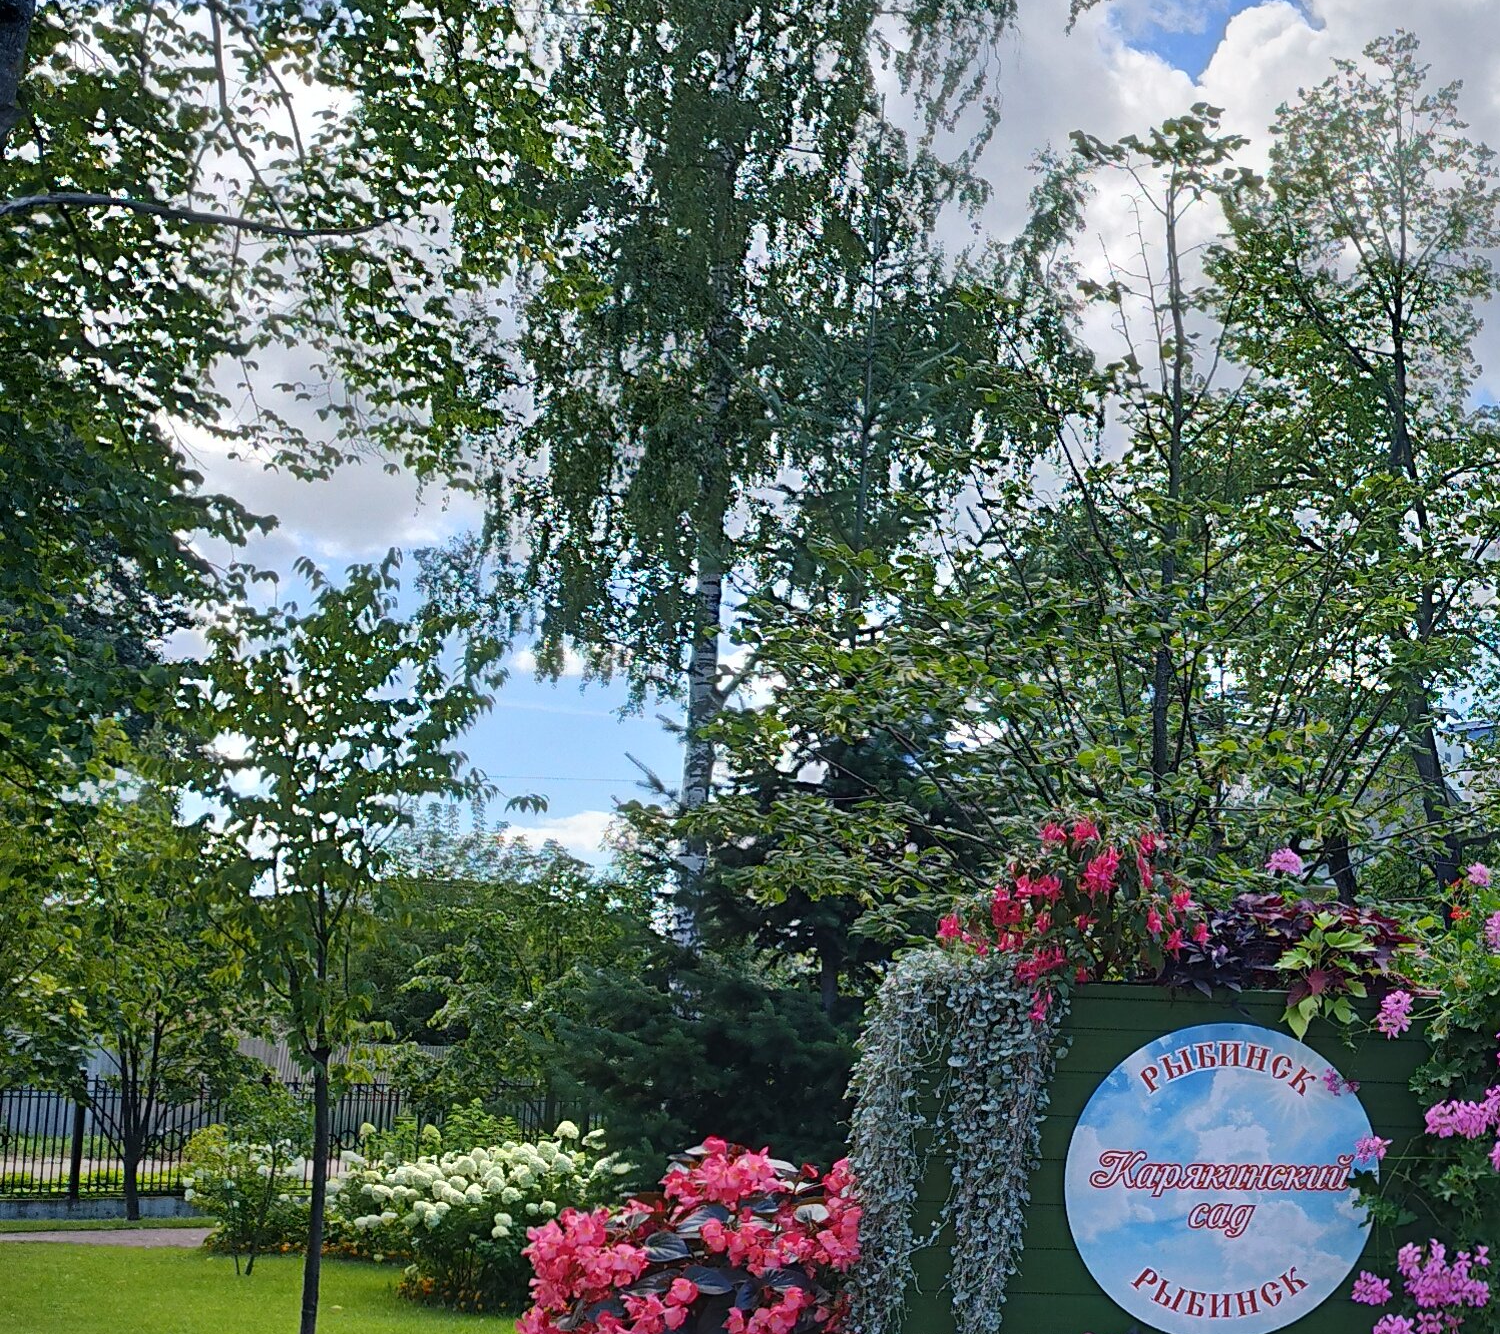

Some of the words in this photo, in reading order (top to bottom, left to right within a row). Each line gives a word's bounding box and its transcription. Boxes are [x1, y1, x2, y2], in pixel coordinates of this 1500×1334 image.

[1140, 1042, 1317, 1096] РЫБИНСК
[1089, 1151, 1354, 1197] Карякинский
[1188, 1203, 1256, 1238] сад
[1131, 1267, 1309, 1318] РЫБИНСК
